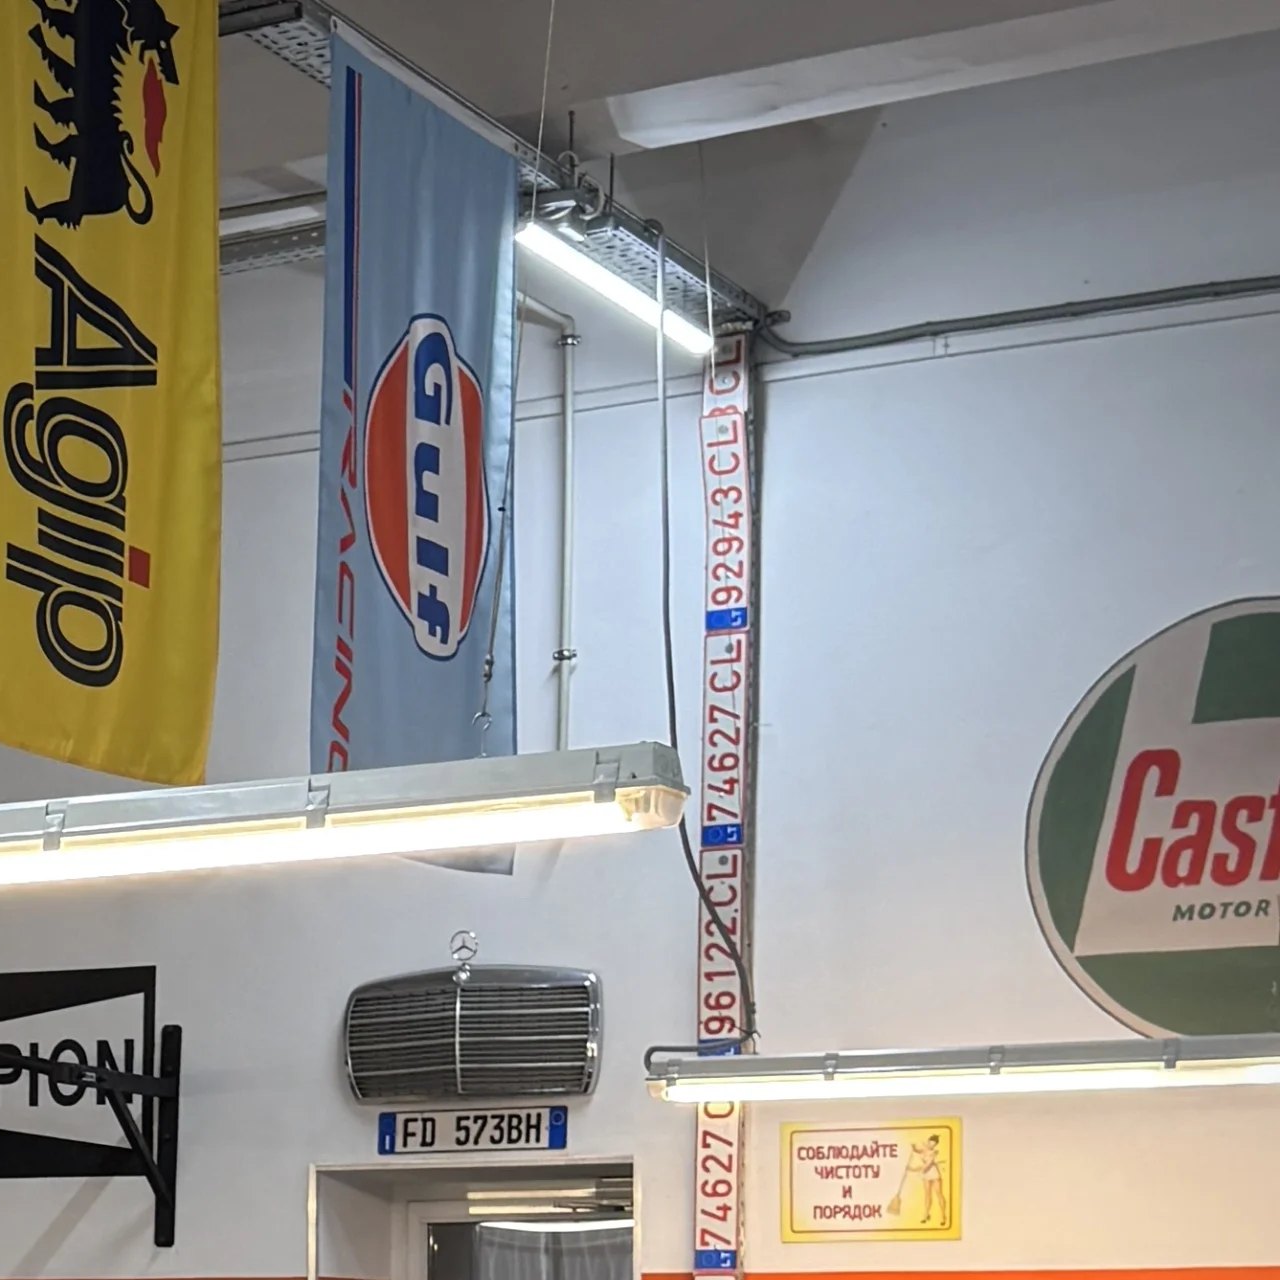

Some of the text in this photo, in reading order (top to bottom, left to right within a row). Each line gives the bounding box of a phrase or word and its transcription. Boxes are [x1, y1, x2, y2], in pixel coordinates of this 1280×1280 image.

[3, 233, 158, 688] Agip
[707, 420, 740, 476] CL
[414, 331, 452, 646] Gulf
[710, 485, 744, 605] 92943
[708, 639, 742, 692] CL
[707, 704, 741, 821] 74627
[1172, 899, 1271, 922] MOTOR
[402, 1117, 436, 1148] FD
[455, 1112, 542, 1146] 573BH
[797, 1141, 898, 1160] СОБЛЮДАЙТЕ
[700, 1129, 735, 1248] 74627
[814, 1165, 880, 1180] ЧИСТОТУ
[842, 1185, 853, 1199] И
[813, 1204, 882, 1221] ПОРЯДОК
